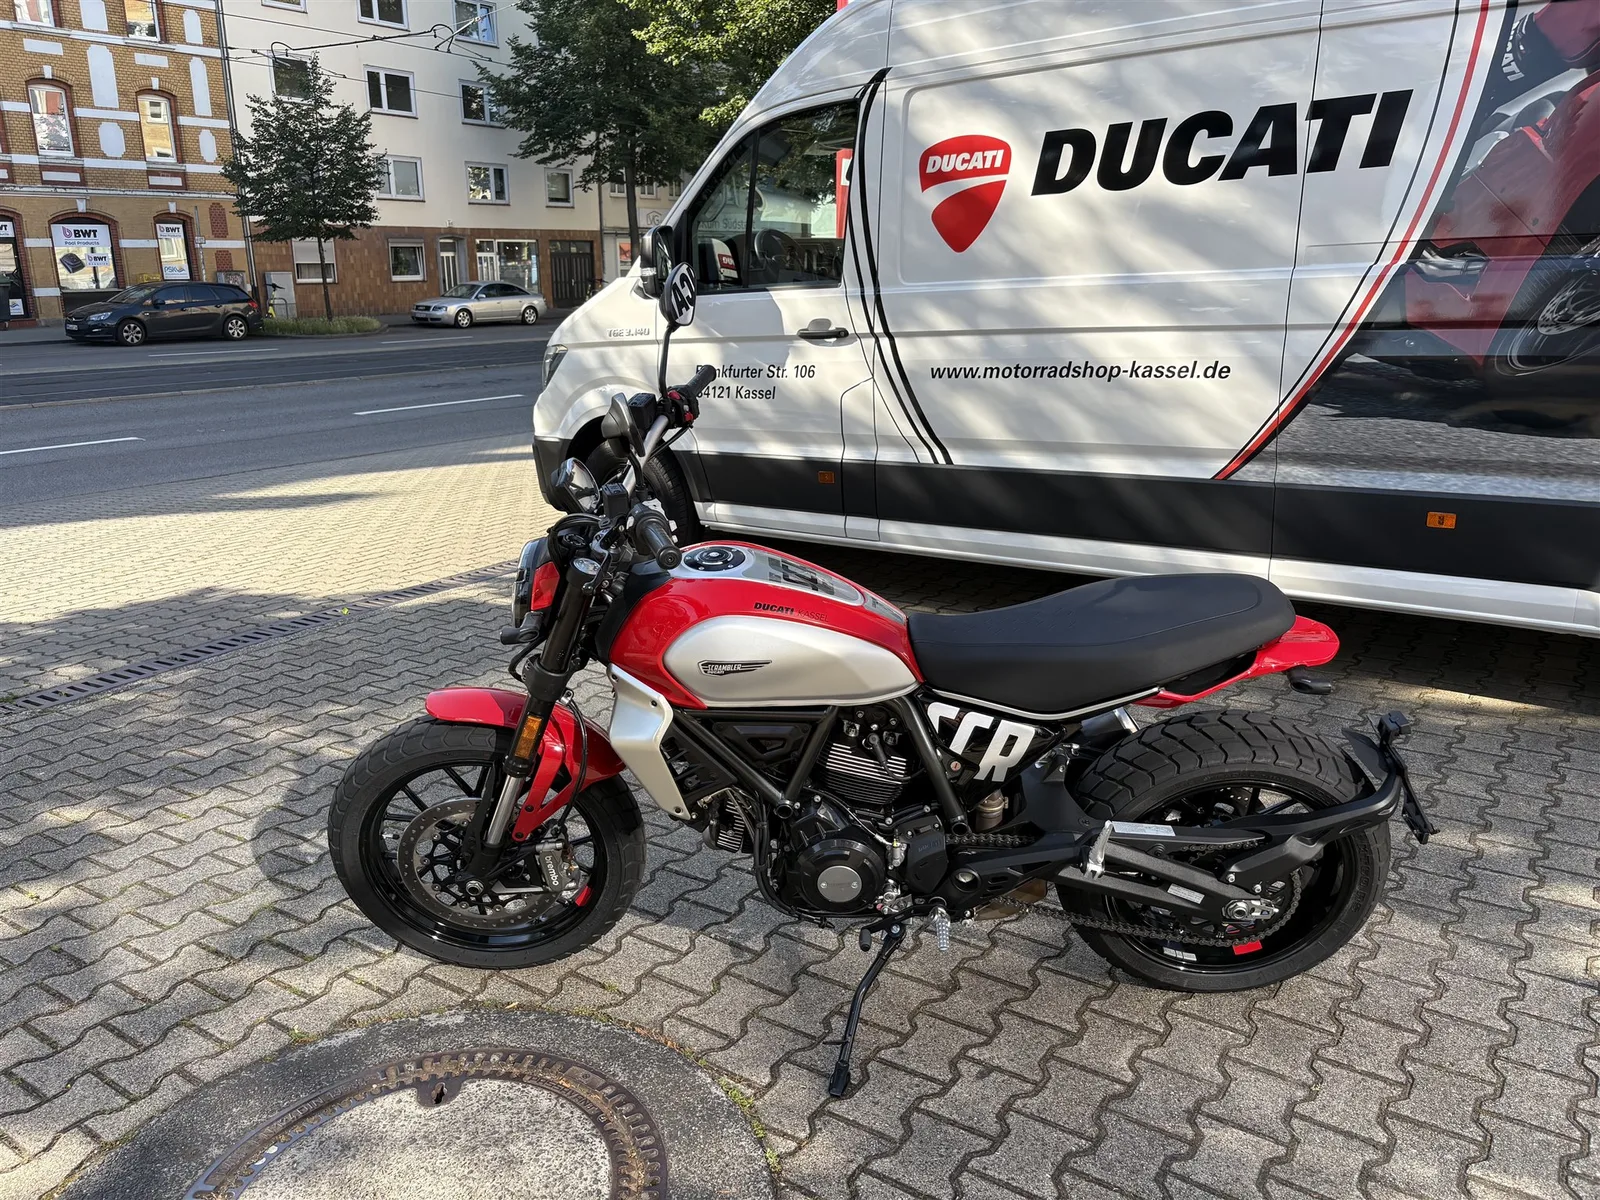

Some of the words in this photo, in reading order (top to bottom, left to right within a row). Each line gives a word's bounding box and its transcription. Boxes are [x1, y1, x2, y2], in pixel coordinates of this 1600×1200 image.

[1031, 89, 1414, 196] DUCATI
[925, 149, 1005, 174] DUCATI
[73, 229, 98, 239] BWT
[696, 364, 763, 379] Fnkfurter
[766, 364, 788, 379] Str.
[794, 364, 816, 379] 106
[930, 360, 1231, 382] www.motorradshop-kassel.de
[735, 385, 776, 400] Kassel
[754, 602, 795, 615] DUCATI
[798, 608, 829, 622] KASSEL
[707, 664, 742, 672] SCRAMBLER
[544, 855, 560, 886] brembo
